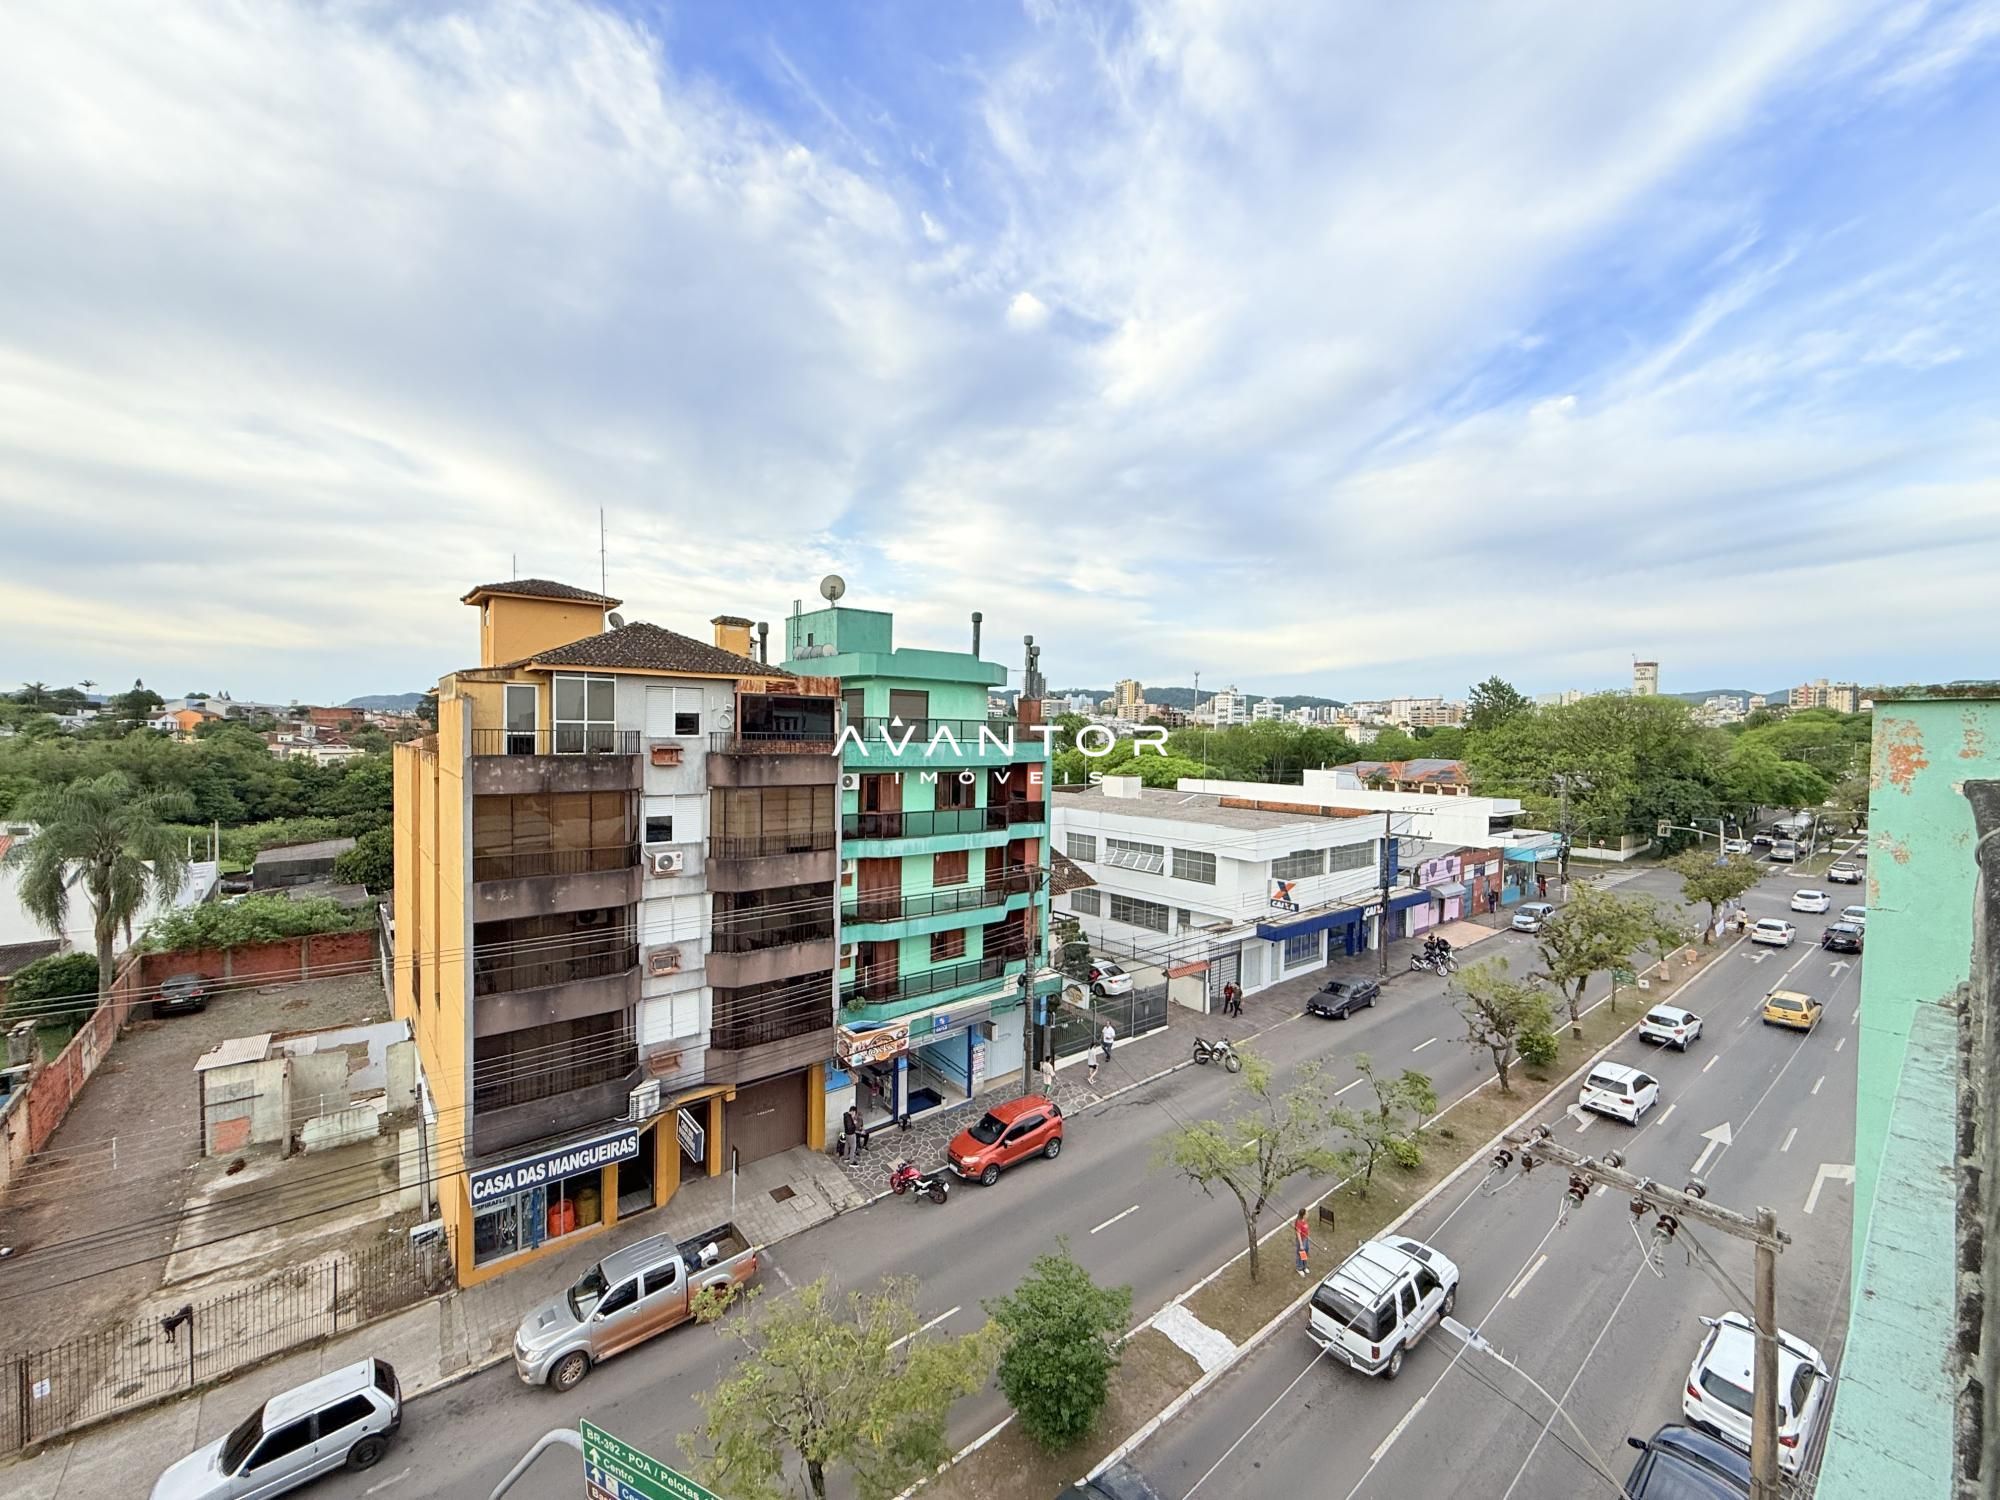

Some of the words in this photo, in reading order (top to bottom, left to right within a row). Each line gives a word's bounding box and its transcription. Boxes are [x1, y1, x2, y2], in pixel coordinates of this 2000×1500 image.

[1271, 901, 1296, 912] CAIXA
[473, 1173, 514, 1199] CASA
[517, 1163, 546, 1187] DAS
[548, 1136, 637, 1177] MANGUEIRAS
[586, 1428, 621, 1456] BR-392
[628, 1453, 652, 1475] POA
[661, 1471, 700, 1500] Pelotas
[603, 1458, 635, 1484] Centro
